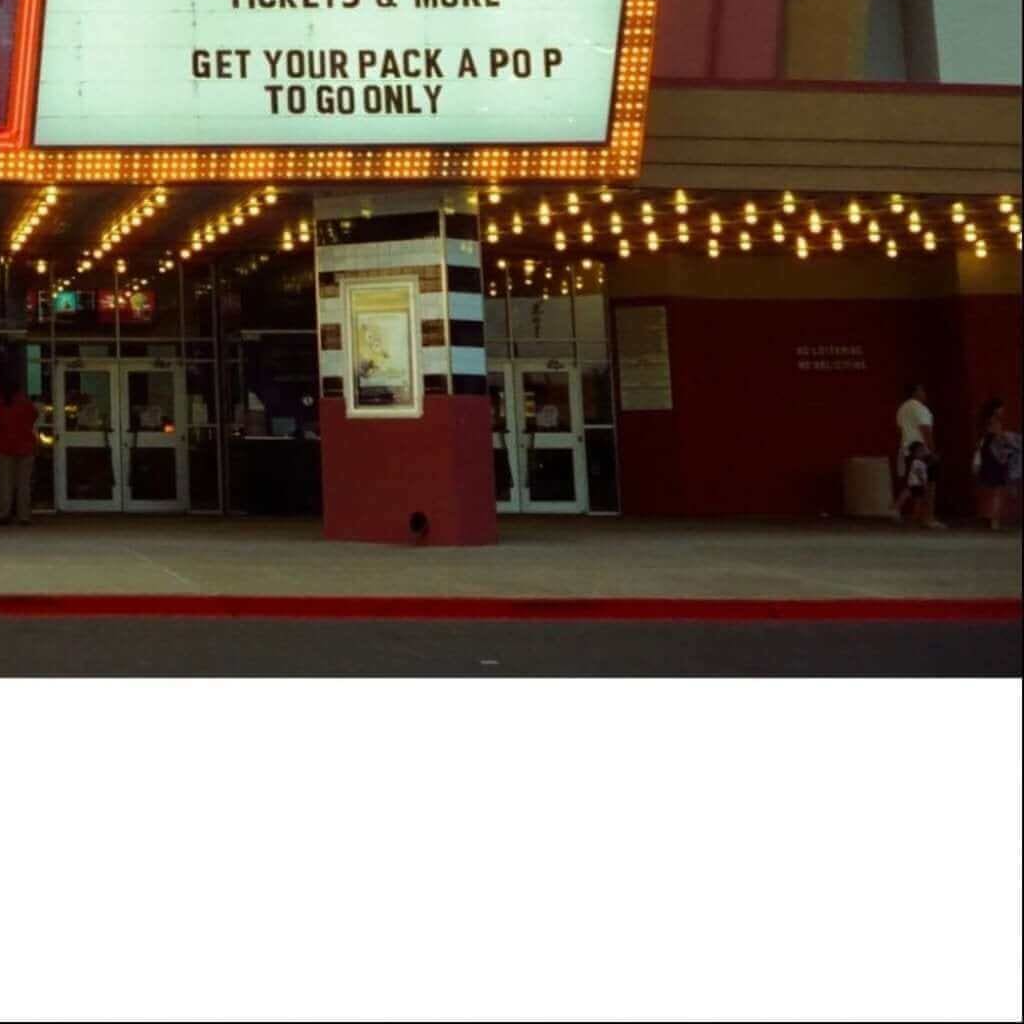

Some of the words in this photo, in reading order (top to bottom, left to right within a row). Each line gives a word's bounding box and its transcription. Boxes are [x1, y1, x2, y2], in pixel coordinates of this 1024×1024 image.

[192, 49, 251, 79] GET
[263, 49, 348, 79] YOUR
[358, 48, 443, 79] PACK
[458, 48, 478, 78] A
[264, 85, 306, 115] TO
[316, 85, 355, 115] GO
[363, 84, 442, 114] ONLY
